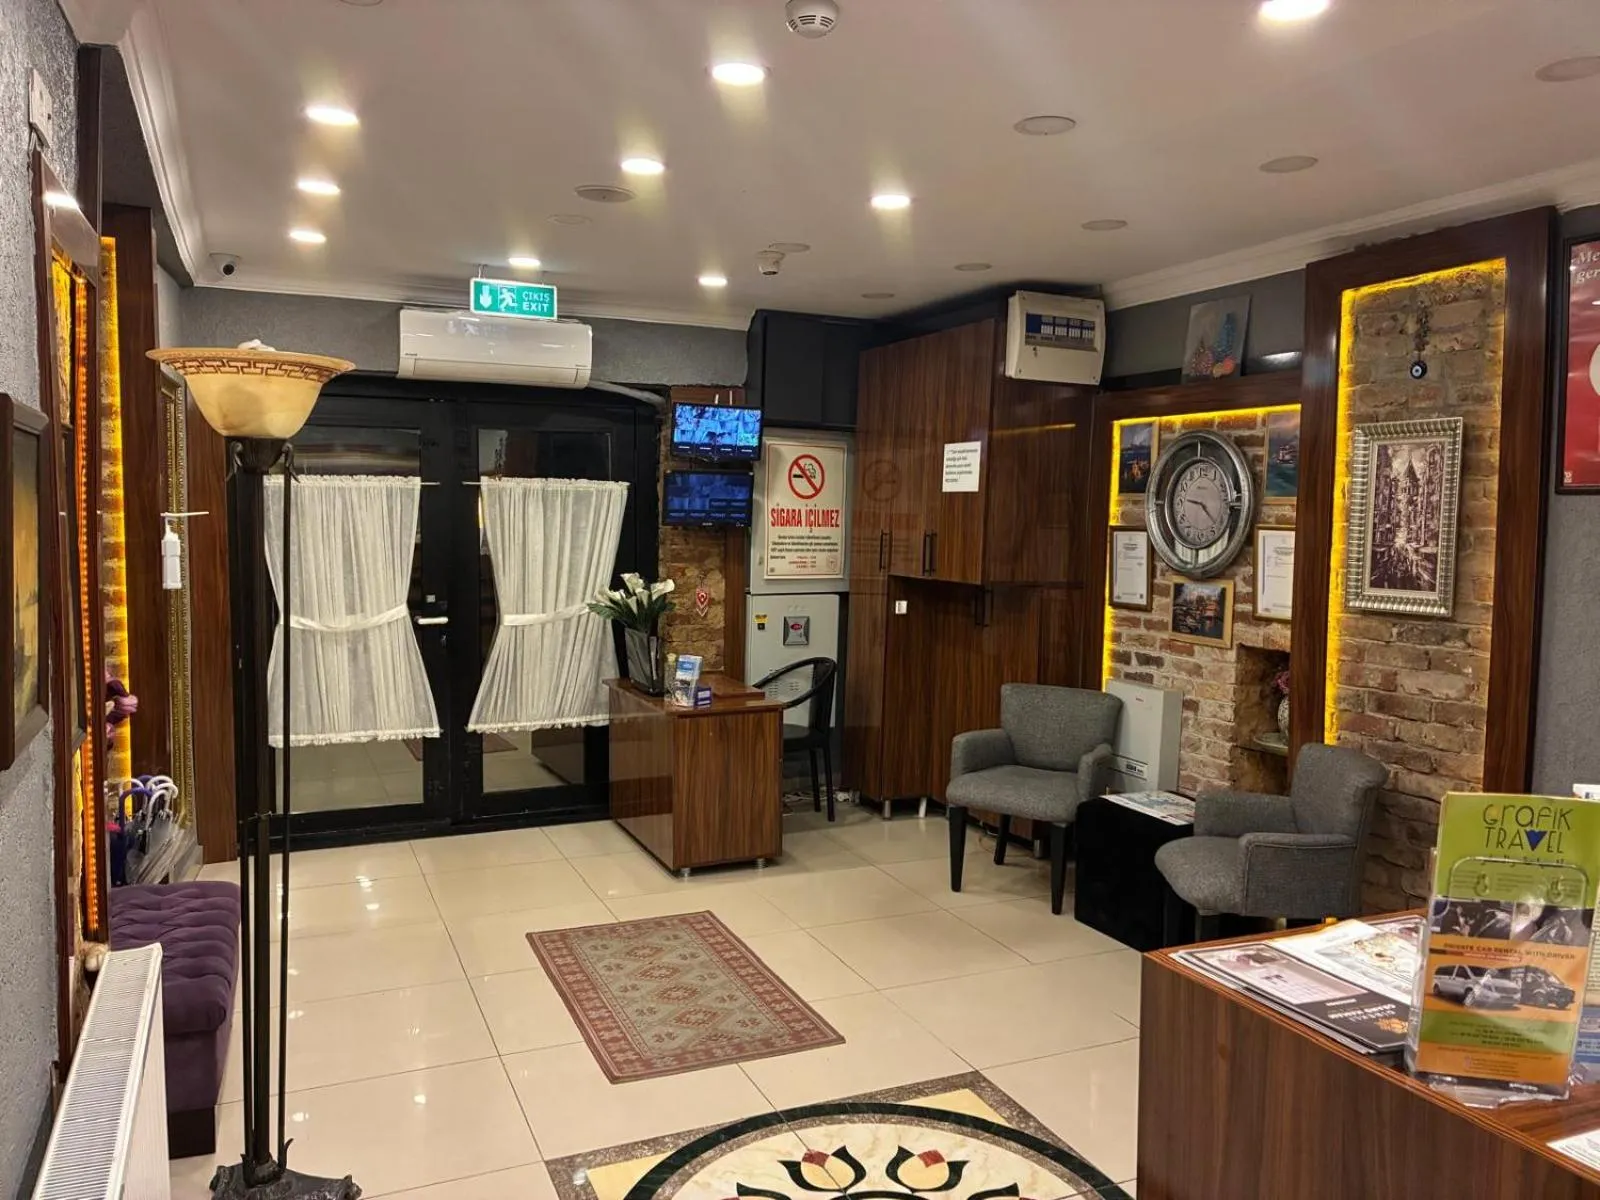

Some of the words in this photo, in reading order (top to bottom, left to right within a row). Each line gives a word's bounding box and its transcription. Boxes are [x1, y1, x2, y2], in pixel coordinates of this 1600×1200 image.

[522, 291, 550, 304] ÇIKIŞ
[522, 302, 550, 313] EXIT
[771, 503, 803, 528] SİGARA
[805, 504, 840, 533] İÇİLMEZ
[1484, 827, 1565, 854] TRAVEL
